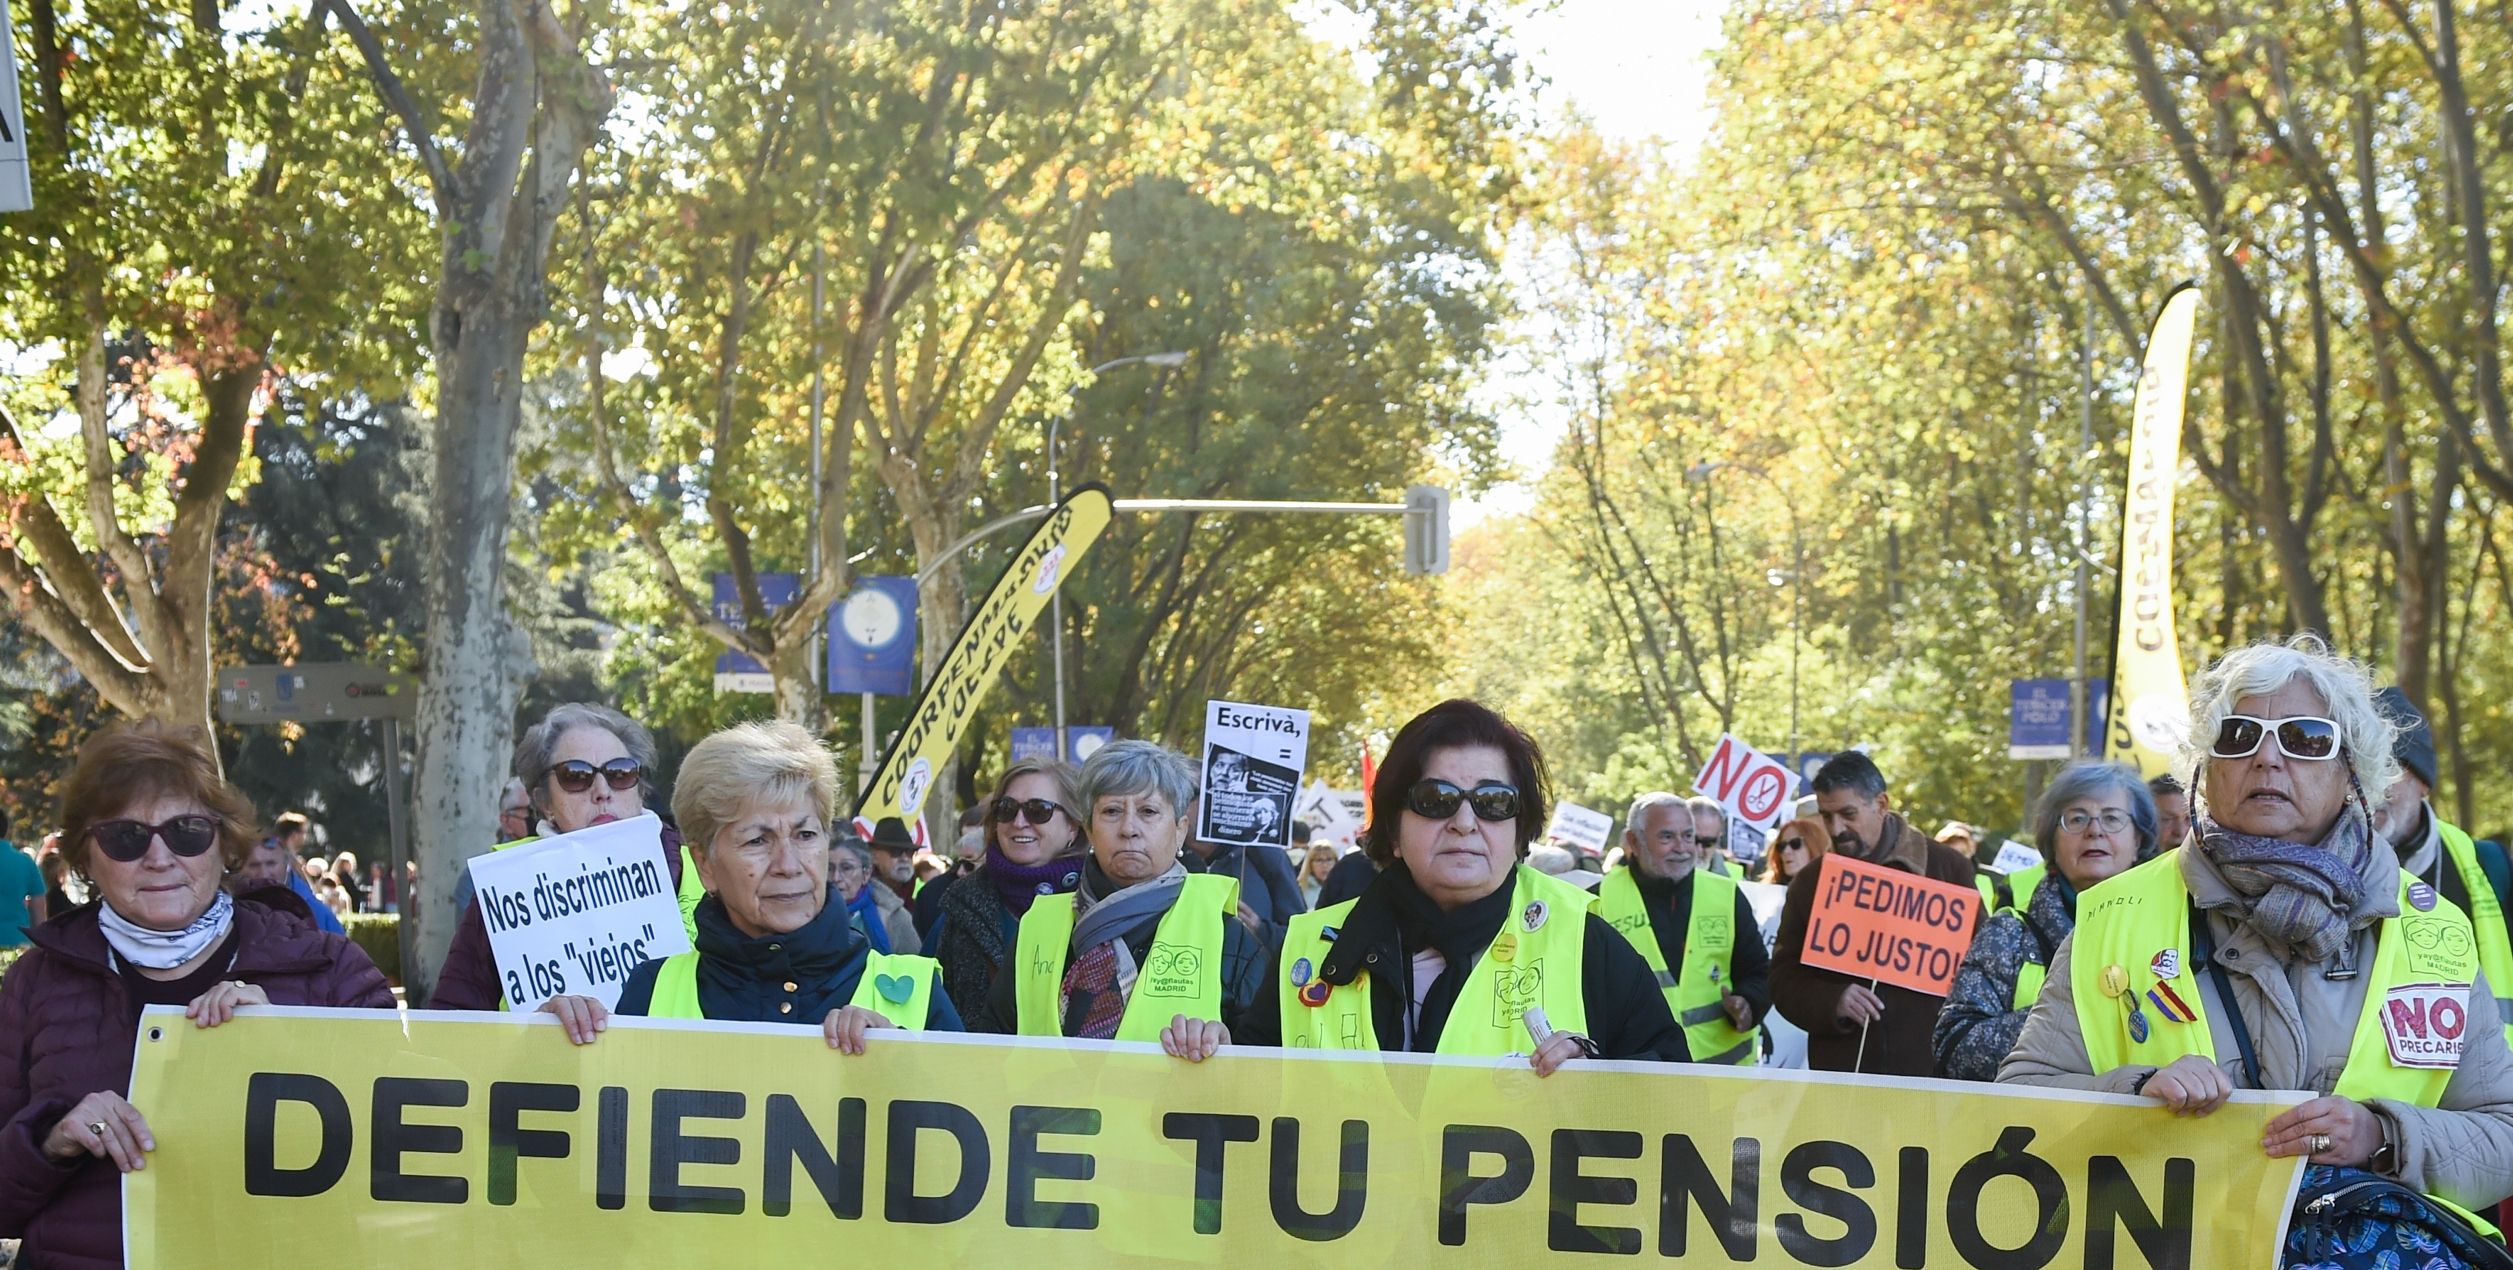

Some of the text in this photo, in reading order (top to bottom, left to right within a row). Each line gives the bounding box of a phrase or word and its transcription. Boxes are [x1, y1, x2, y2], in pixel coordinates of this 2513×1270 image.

[1698, 738, 1786, 822] NO
[481, 856, 661, 934] Nos discriminan
[1825, 870, 1965, 932] ¡PEDIMOS
[507, 970, 526, 1006] a
[523, 954, 566, 1001] los
[1810, 918, 1960, 984] LO JUSTO!
[2427, 961, 2459, 976] MADRID
[2387, 996, 2465, 1041] NO
[245, 1073, 2195, 1270] DEFIENDE TU PENSIÓN
